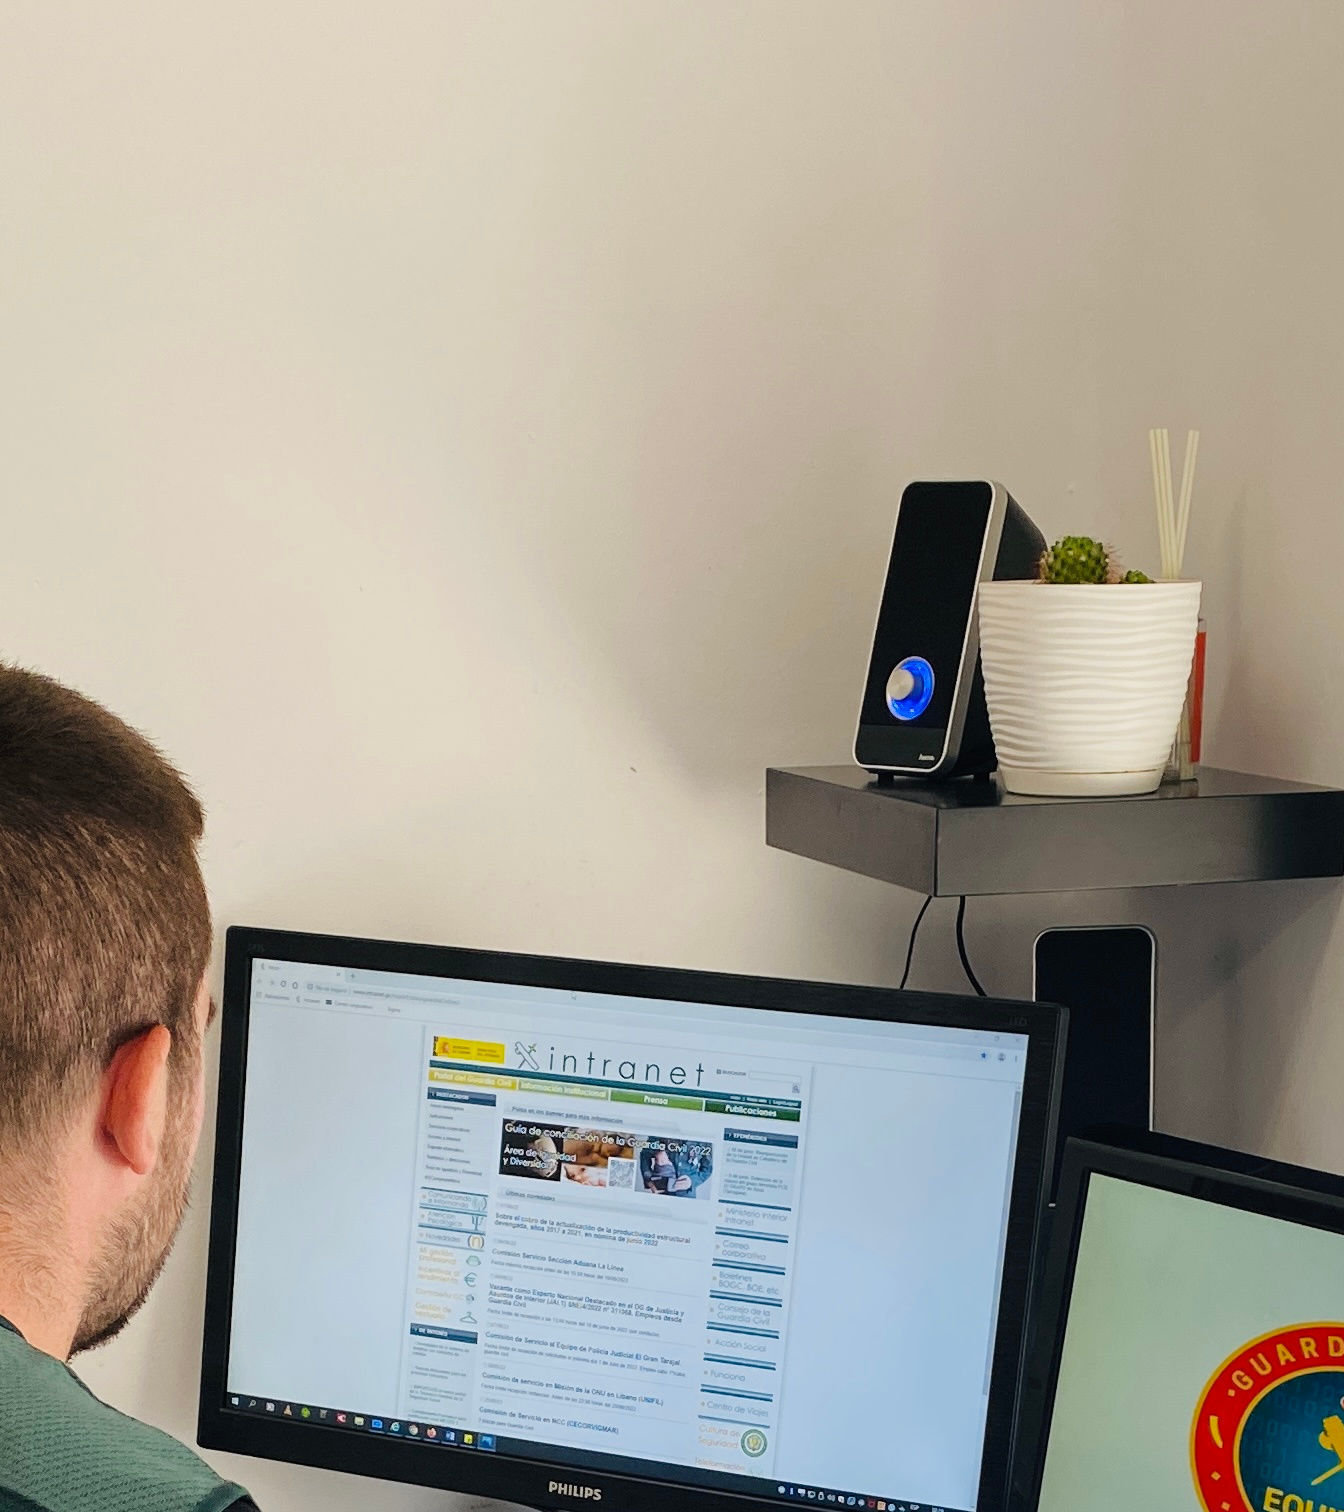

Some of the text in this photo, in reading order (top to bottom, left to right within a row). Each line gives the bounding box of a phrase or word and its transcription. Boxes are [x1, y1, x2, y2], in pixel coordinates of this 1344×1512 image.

[549, 1046, 704, 1087] intranet
[643, 1095, 668, 1105] Prensa
[725, 1104, 777, 1117] Publicaciones
[505, 1122, 710, 1156] Guía de conciliación de la Guardia Civil 2022
[503, 1143, 524, 1155] Área
[525, 1148, 536, 1157] de
[502, 1157, 507, 1165] y
[717, 1302, 770, 1317] Consejo de la
[716, 1311, 769, 1325] Guardia Civil
[710, 1369, 745, 1381] Funciona
[548, 1480, 602, 1501] PHILIPS
